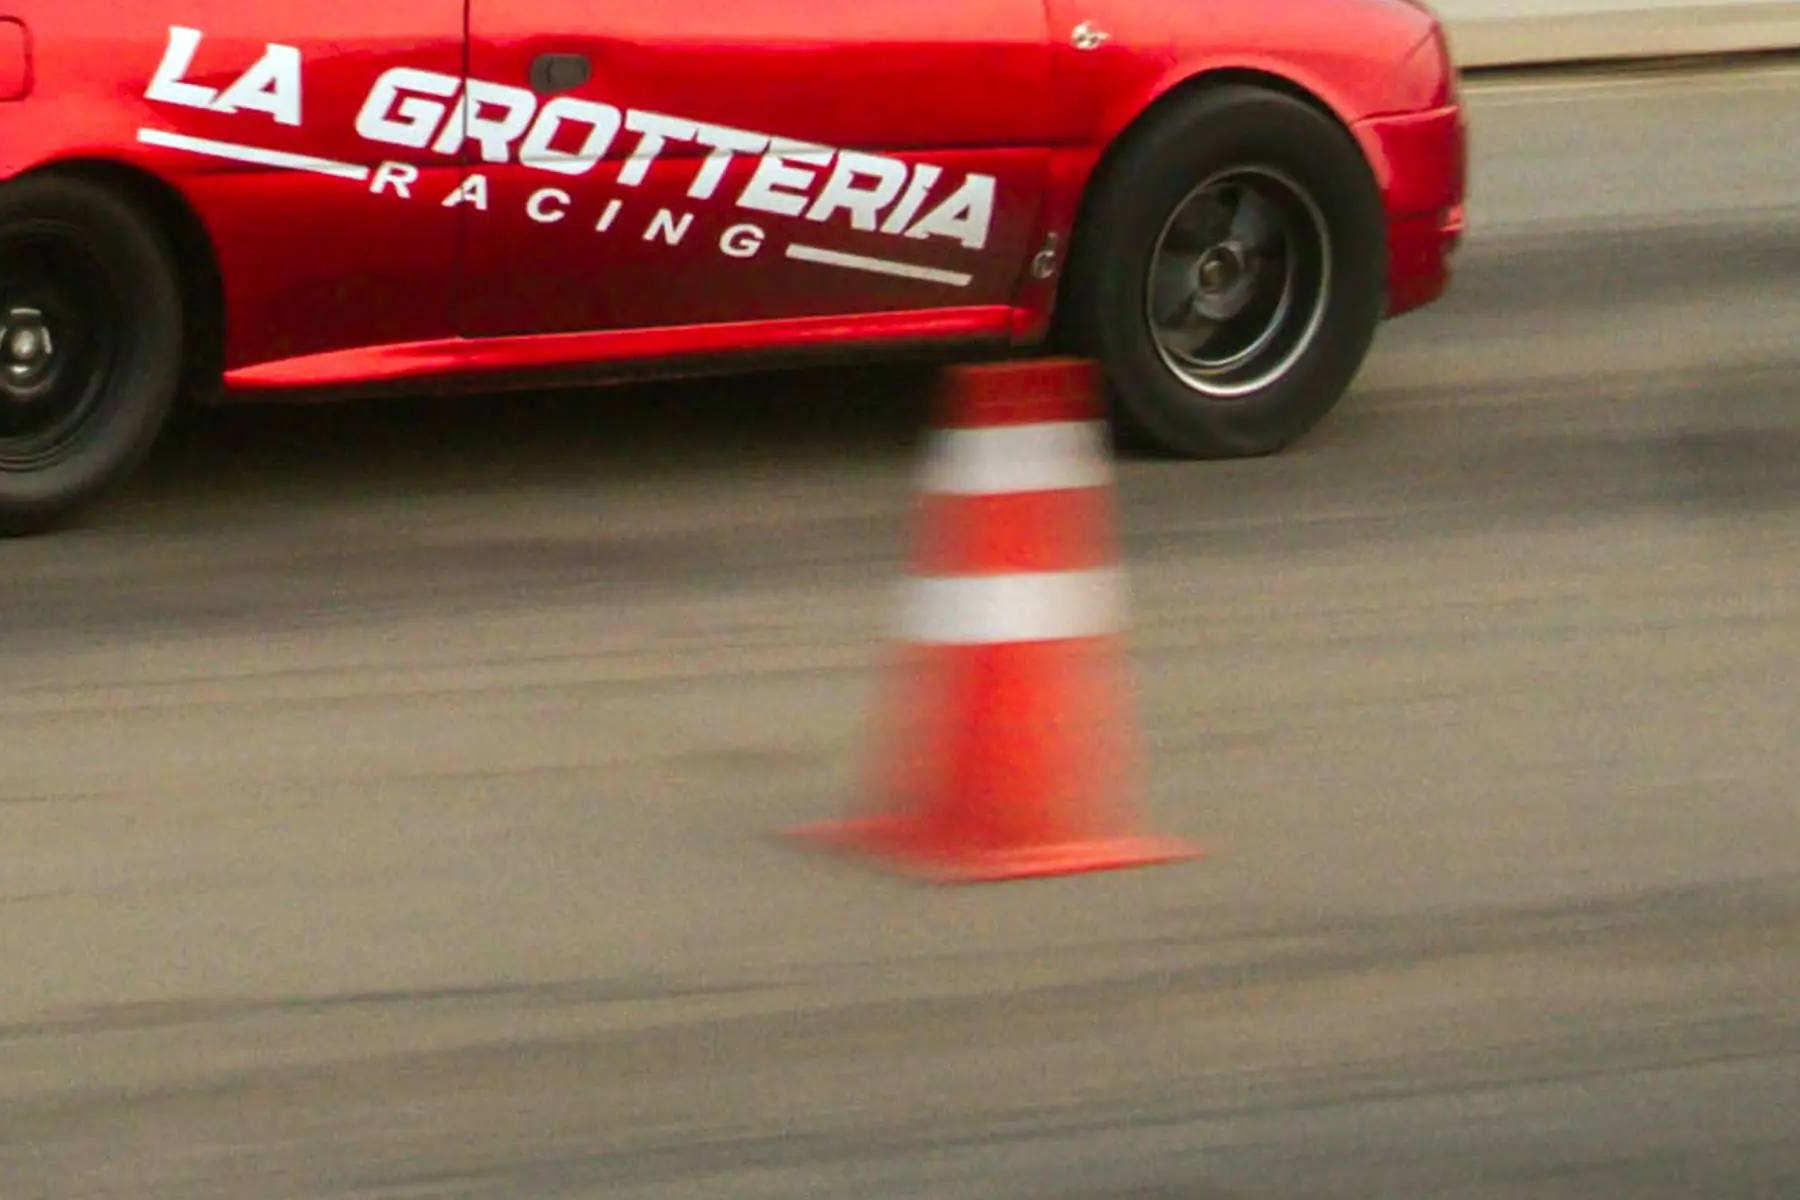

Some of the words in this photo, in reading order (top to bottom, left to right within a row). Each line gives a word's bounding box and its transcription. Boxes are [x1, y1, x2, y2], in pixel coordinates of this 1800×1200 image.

[144, 26, 303, 126] LA
[355, 66, 997, 250] GROTTERIA
[368, 161, 766, 259] RACING
